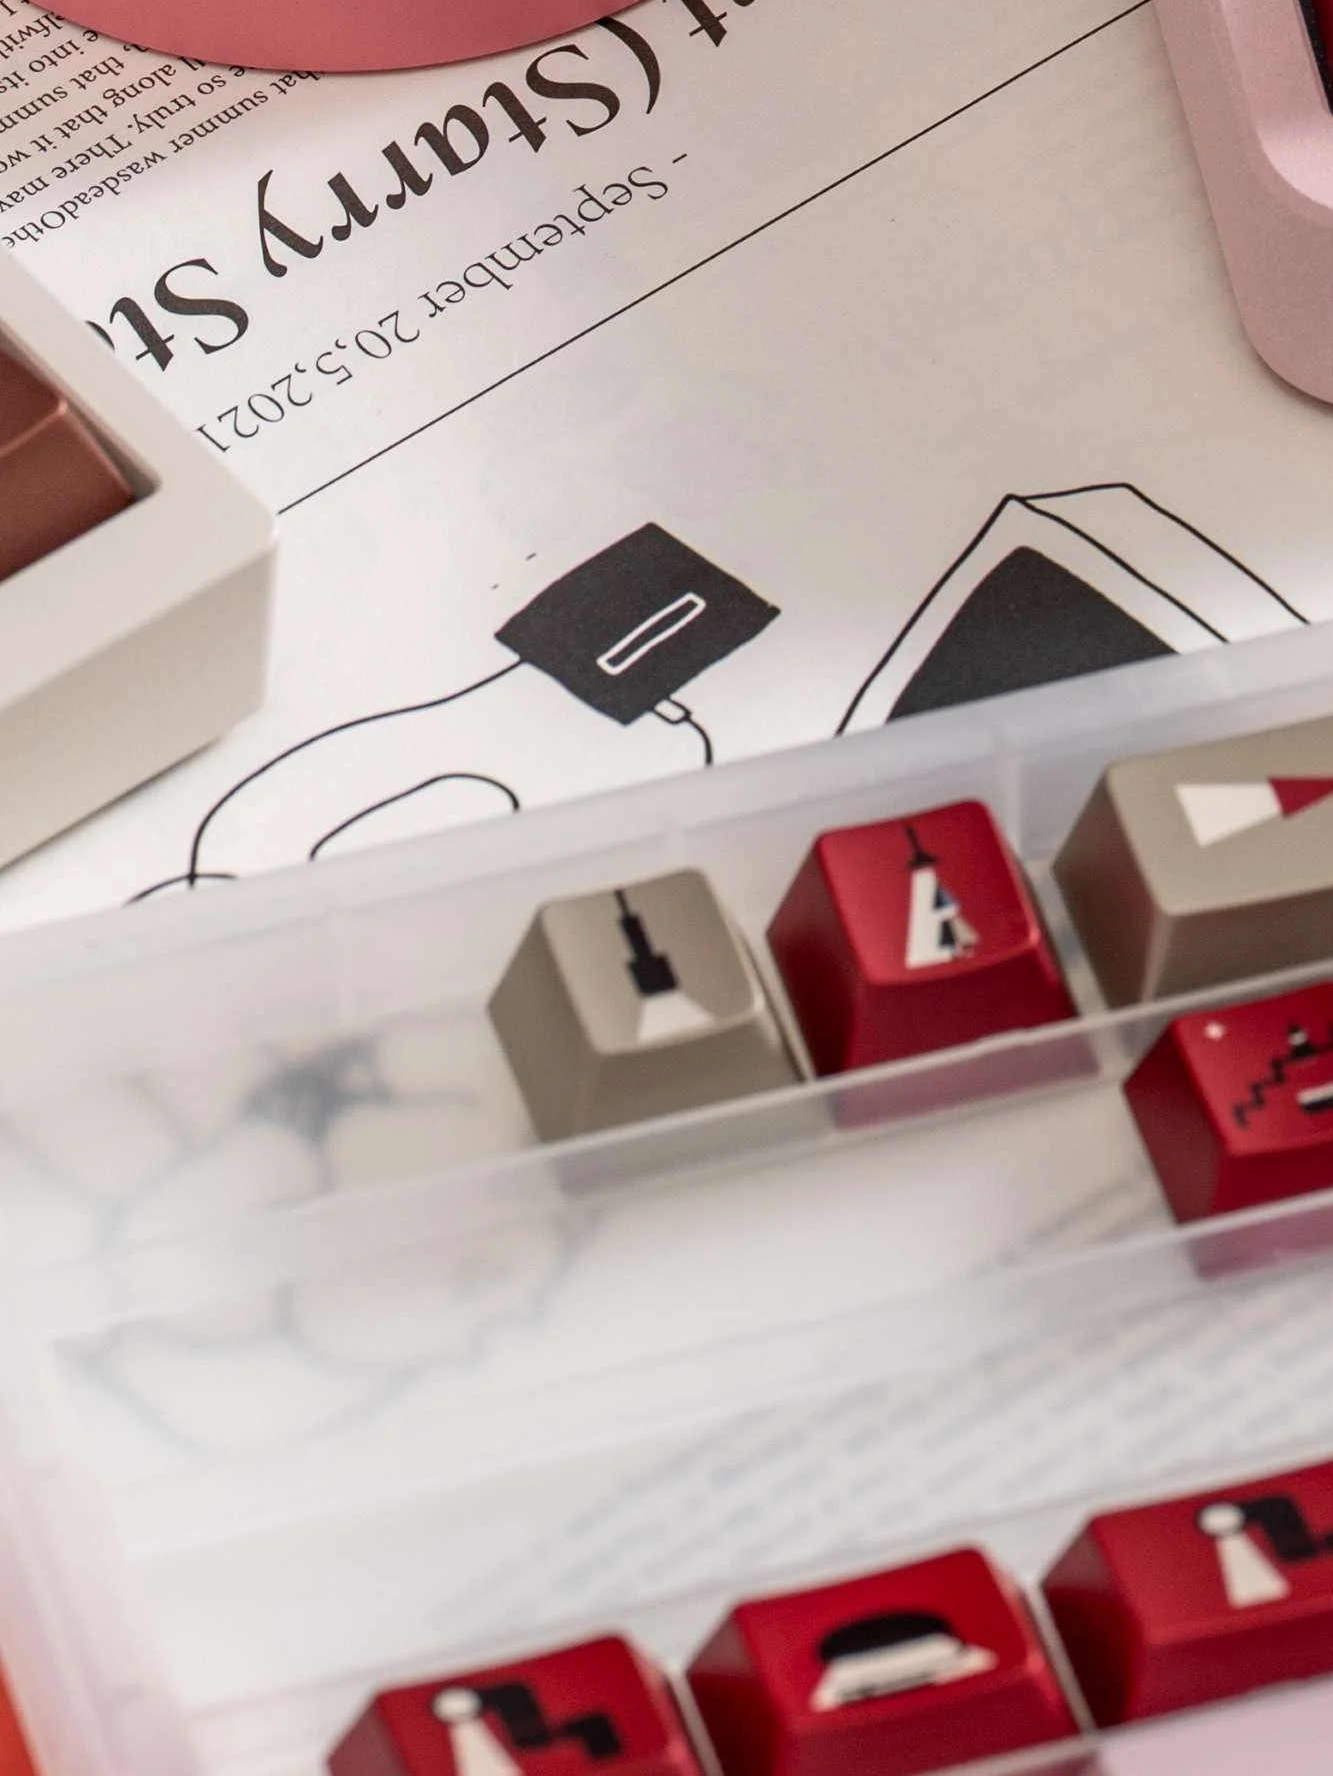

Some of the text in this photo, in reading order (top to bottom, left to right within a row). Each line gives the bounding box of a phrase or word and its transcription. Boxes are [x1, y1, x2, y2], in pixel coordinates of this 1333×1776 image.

[28, 39, 84, 72] into
[69, 56, 124, 90] that
[29, 64, 175, 152] along that it
[51, 75, 226, 178] so truly. There
[168, 90, 268, 153] summer
[256, 15, 664, 279] (Starry
[419, 166, 667, 317] September
[86, 255, 252, 372] St
